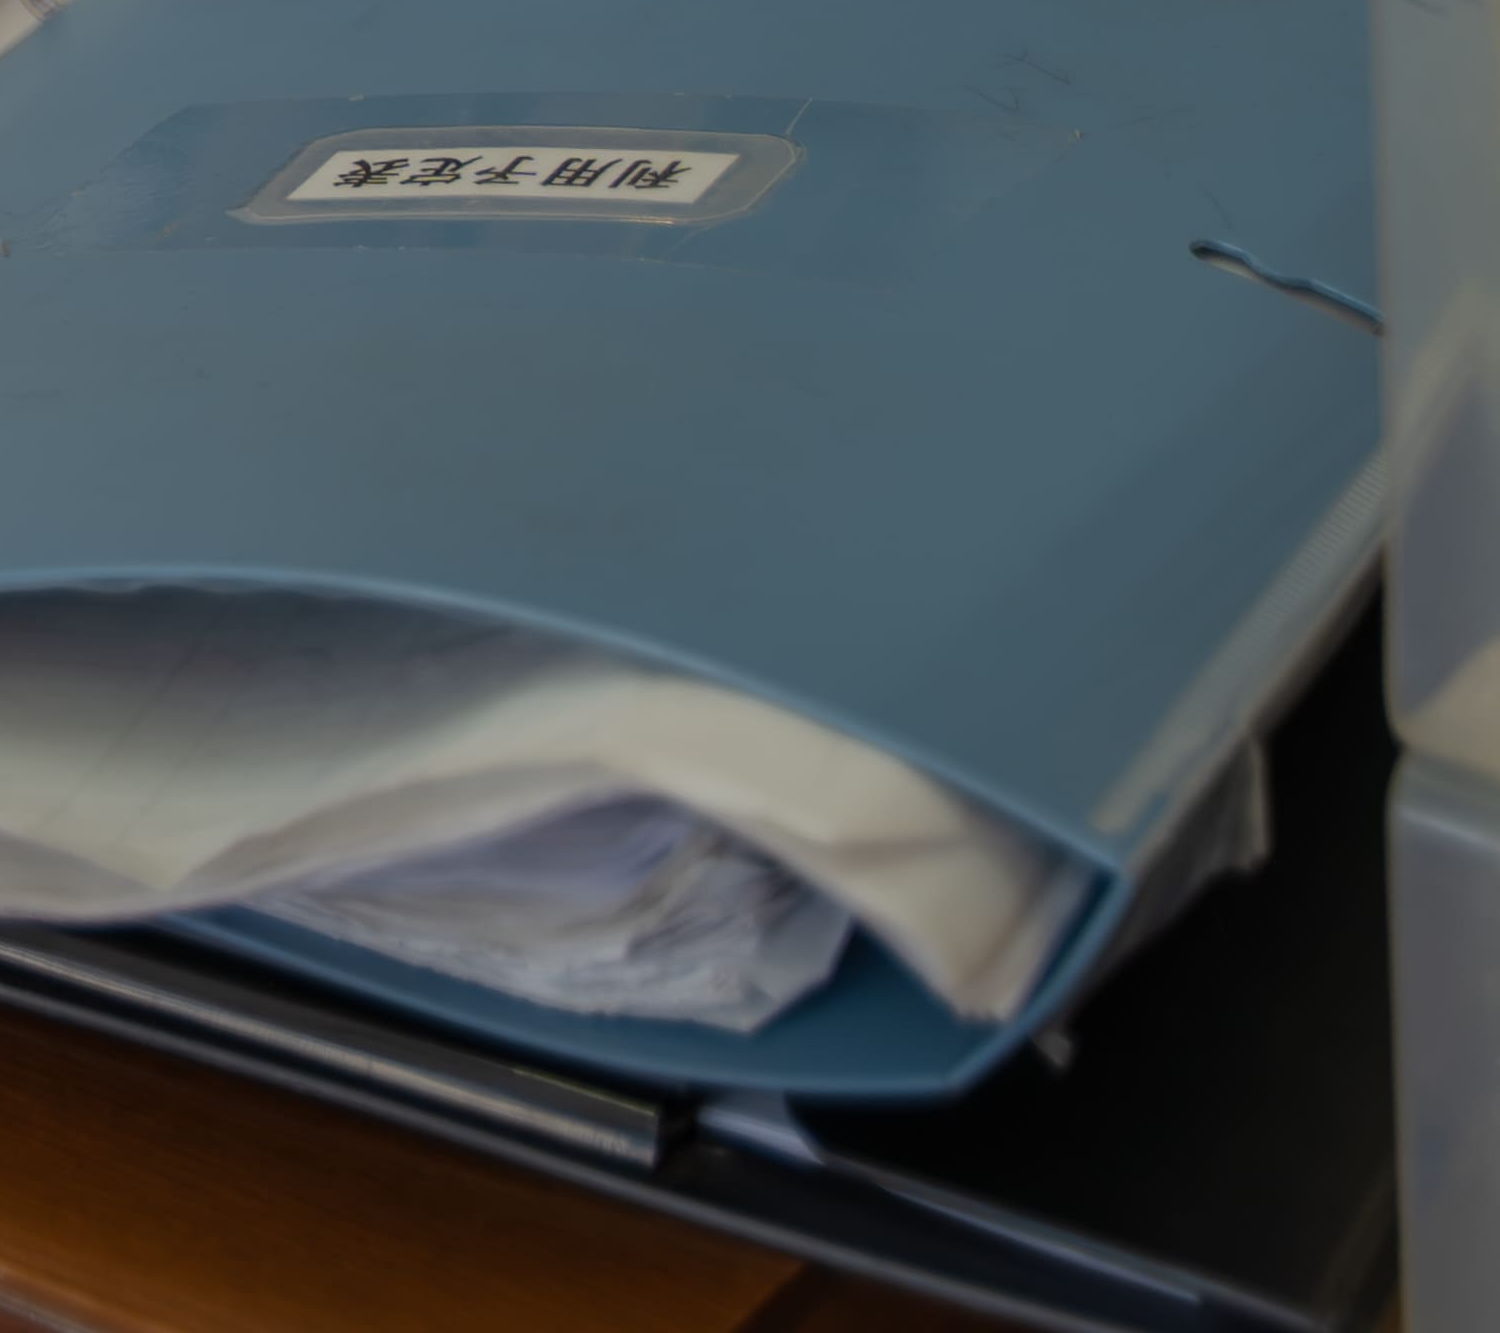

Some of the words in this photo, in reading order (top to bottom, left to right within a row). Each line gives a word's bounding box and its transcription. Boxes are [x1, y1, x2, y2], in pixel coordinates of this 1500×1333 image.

[332, 155, 694, 190] 利用予定表
